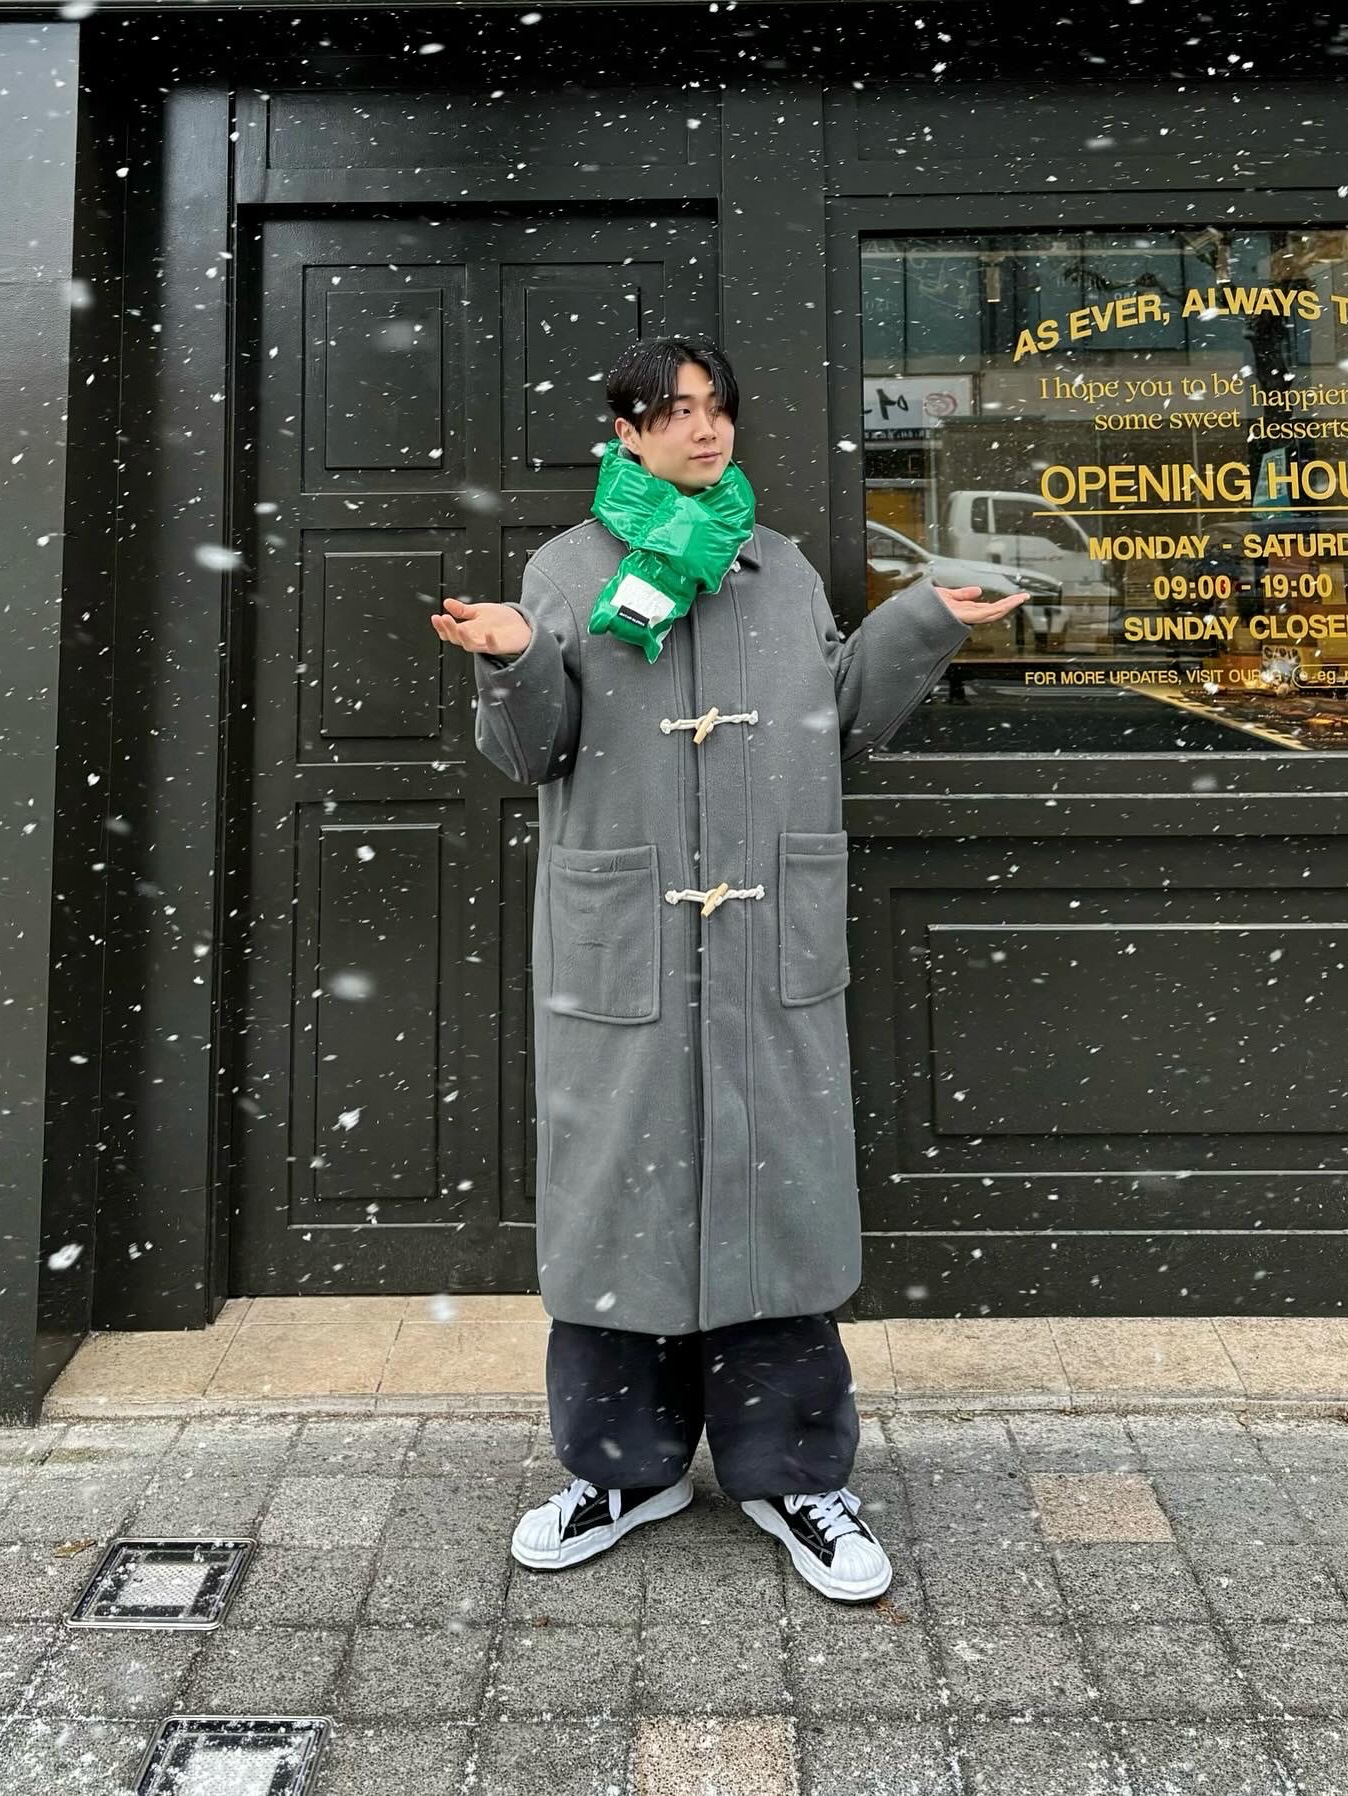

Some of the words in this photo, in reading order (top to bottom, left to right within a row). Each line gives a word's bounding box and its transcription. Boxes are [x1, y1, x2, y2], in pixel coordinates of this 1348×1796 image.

[1013, 319, 1060, 363] AS
[1069, 293, 1171, 341] EVER,
[1181, 287, 1321, 321] ALWAYS
[1039, 377, 1050, 400] I
[1053, 376, 1120, 404] hope
[1125, 378, 1175, 403] you
[1181, 376, 1207, 397] to
[1211, 372, 1245, 396] be
[1094, 411, 1163, 431] some
[1169, 407, 1241, 429] sweet
[1040, 461, 1251, 505] OPENING
[1088, 535, 1210, 561] MONDAY
[1153, 574, 1232, 601] 09:00
[1260, 573, 1333, 598] 19:00
[1123, 615, 1239, 642] SUNDAY
[1024, 671, 1056, 685] FOR
[1060, 671, 1106, 685] MORE
[1109, 669, 1182, 686] UPDATES,
[1185, 669, 1224, 683] VISIT
[1228, 669, 1263, 684] OUR
